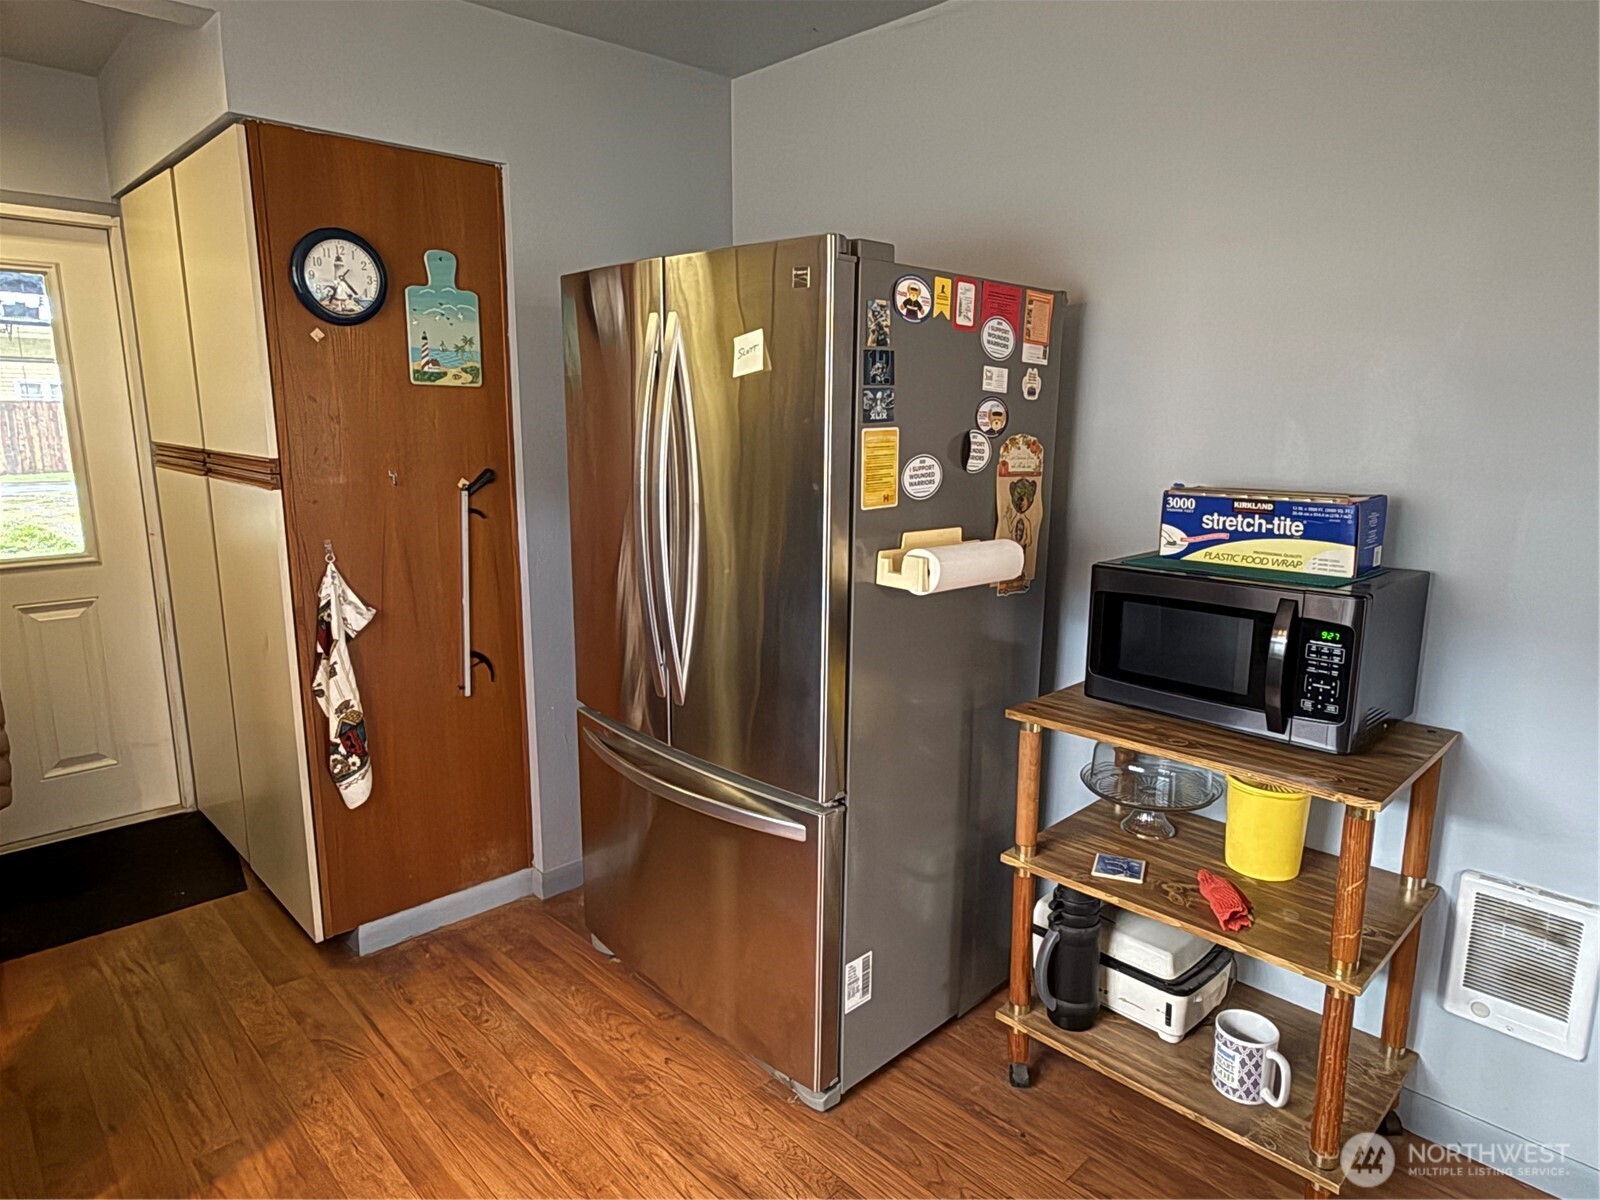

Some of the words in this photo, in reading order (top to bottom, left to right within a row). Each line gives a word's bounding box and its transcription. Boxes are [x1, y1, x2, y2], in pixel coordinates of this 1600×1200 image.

[322, 248, 331, 258] 11
[335, 245, 345, 256] 12
[312, 256, 322, 266] 10
[360, 261, 367, 271] 2
[308, 270, 315, 280] 9
[366, 275, 373, 285] 3
[991, 325, 1010, 336] SUPPORT
[987, 332, 1010, 343] WOUNDED
[986, 338, 1009, 350] WARRIORS
[870, 411, 888, 421] XLIX
[912, 464, 935, 473] SUPPORT
[908, 472, 936, 480] WOUNDED
[908, 479, 936, 488] WARRIORS
[1165, 497, 1196, 510] 3000
[1233, 501, 1274, 511] KIRKLAND
[1201, 512, 1304, 536] stretch-tite
[1203, 551, 1238, 563] PLASTIC
[1240, 555, 1269, 566] FOOD
[1271, 557, 1303, 569] WRAP
